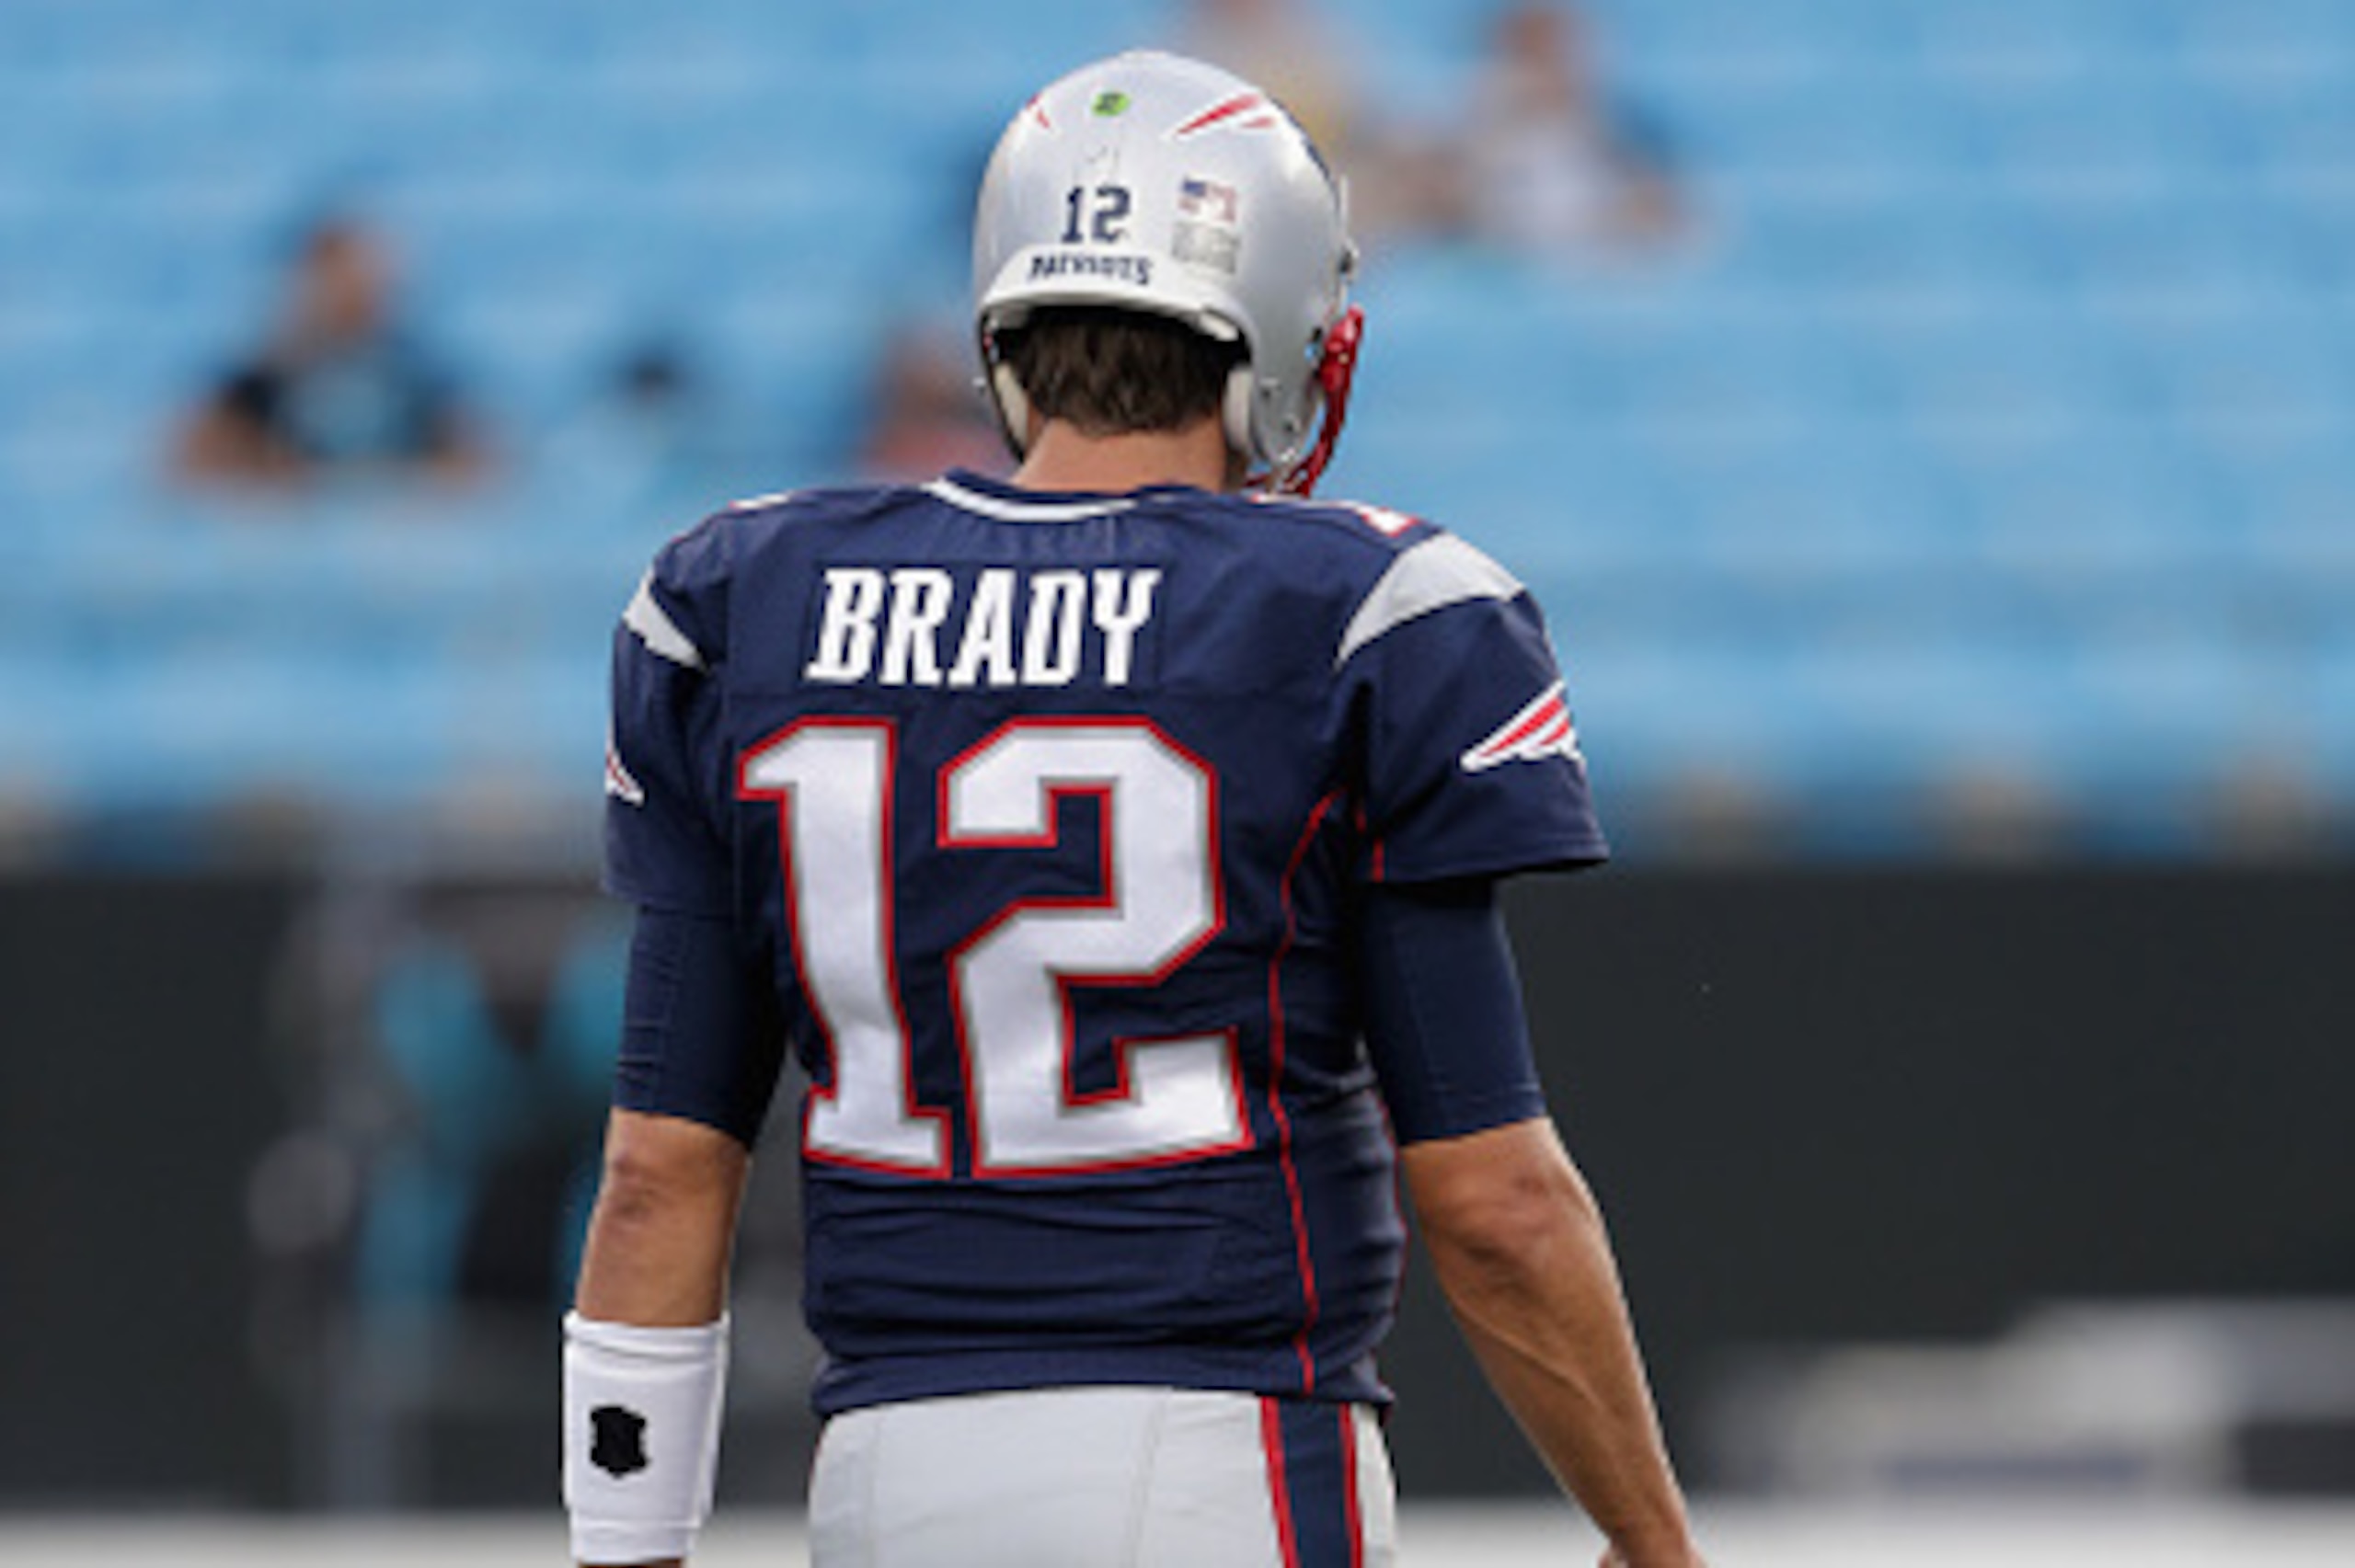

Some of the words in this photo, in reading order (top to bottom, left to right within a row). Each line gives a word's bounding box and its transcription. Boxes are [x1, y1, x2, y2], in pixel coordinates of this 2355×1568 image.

[1061, 185, 1131, 244] 12
[805, 567, 1163, 686] BRADY
[736, 715, 1255, 1180] 12
